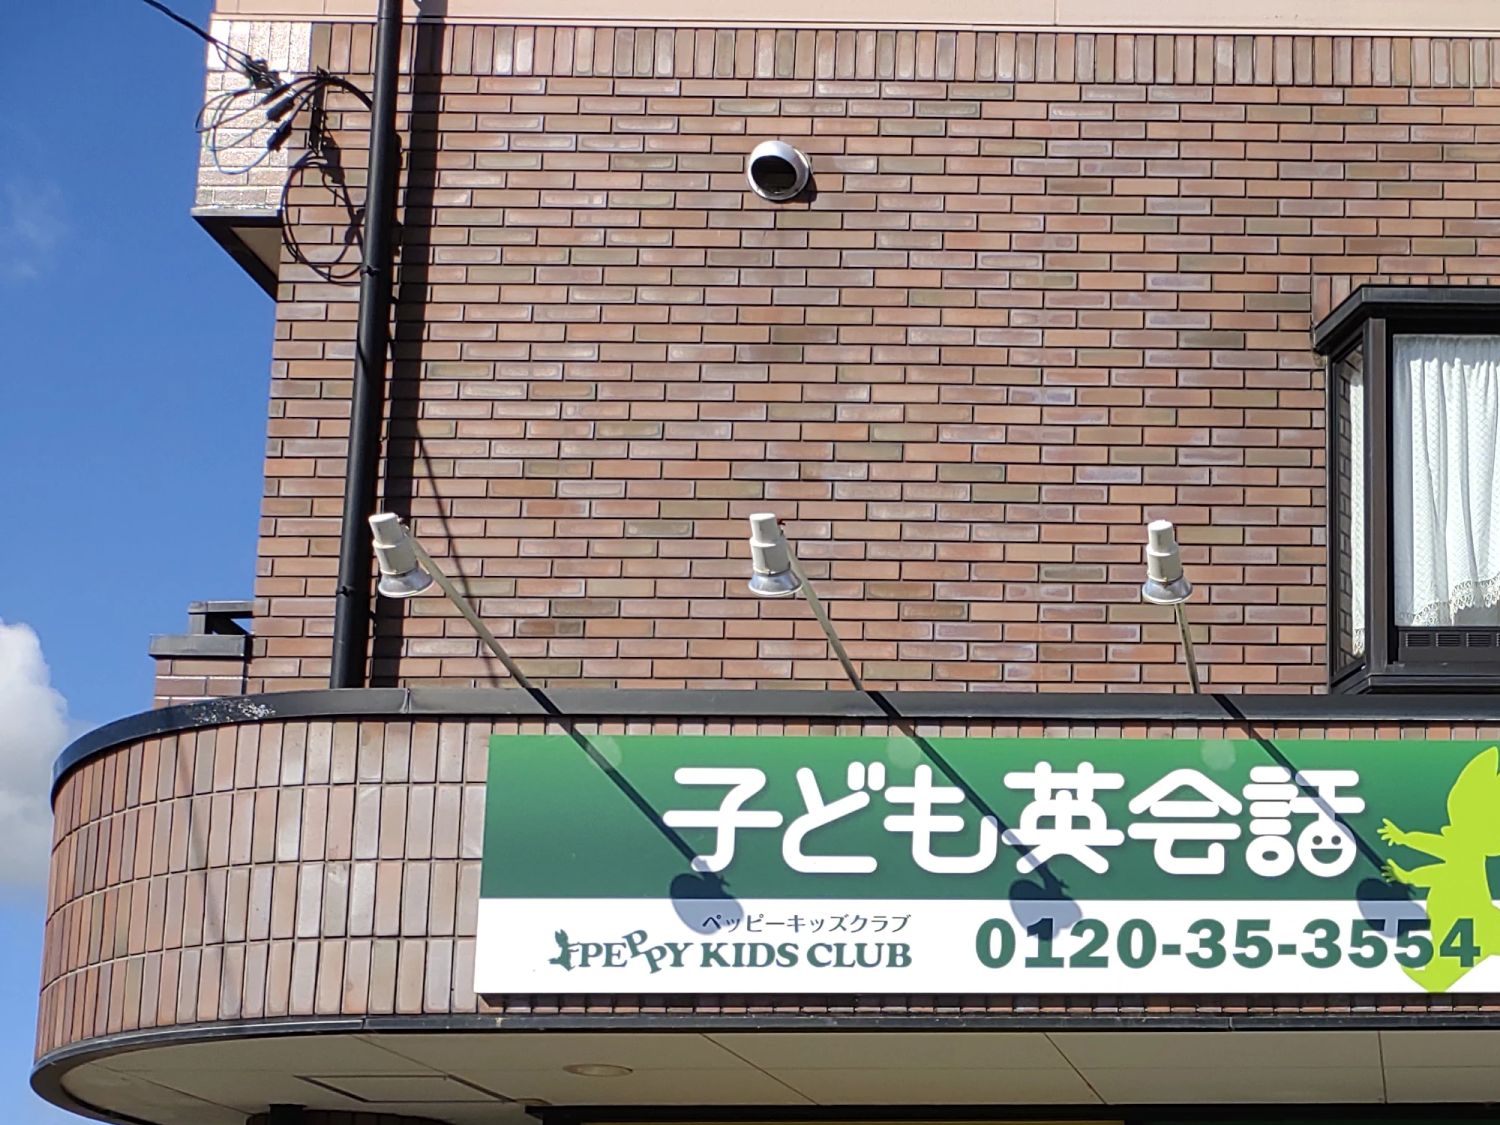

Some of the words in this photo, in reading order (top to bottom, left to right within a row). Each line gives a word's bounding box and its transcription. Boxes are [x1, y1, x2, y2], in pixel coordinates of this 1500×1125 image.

[662, 760, 1366, 878] 子ども英会話
[701, 913, 912, 935] ペッピーキッズクラブ
[974, 917, 1482, 970] 0120-35-3554
[701, 942, 799, 969] KIDS
[806, 942, 913, 969] CLUB
